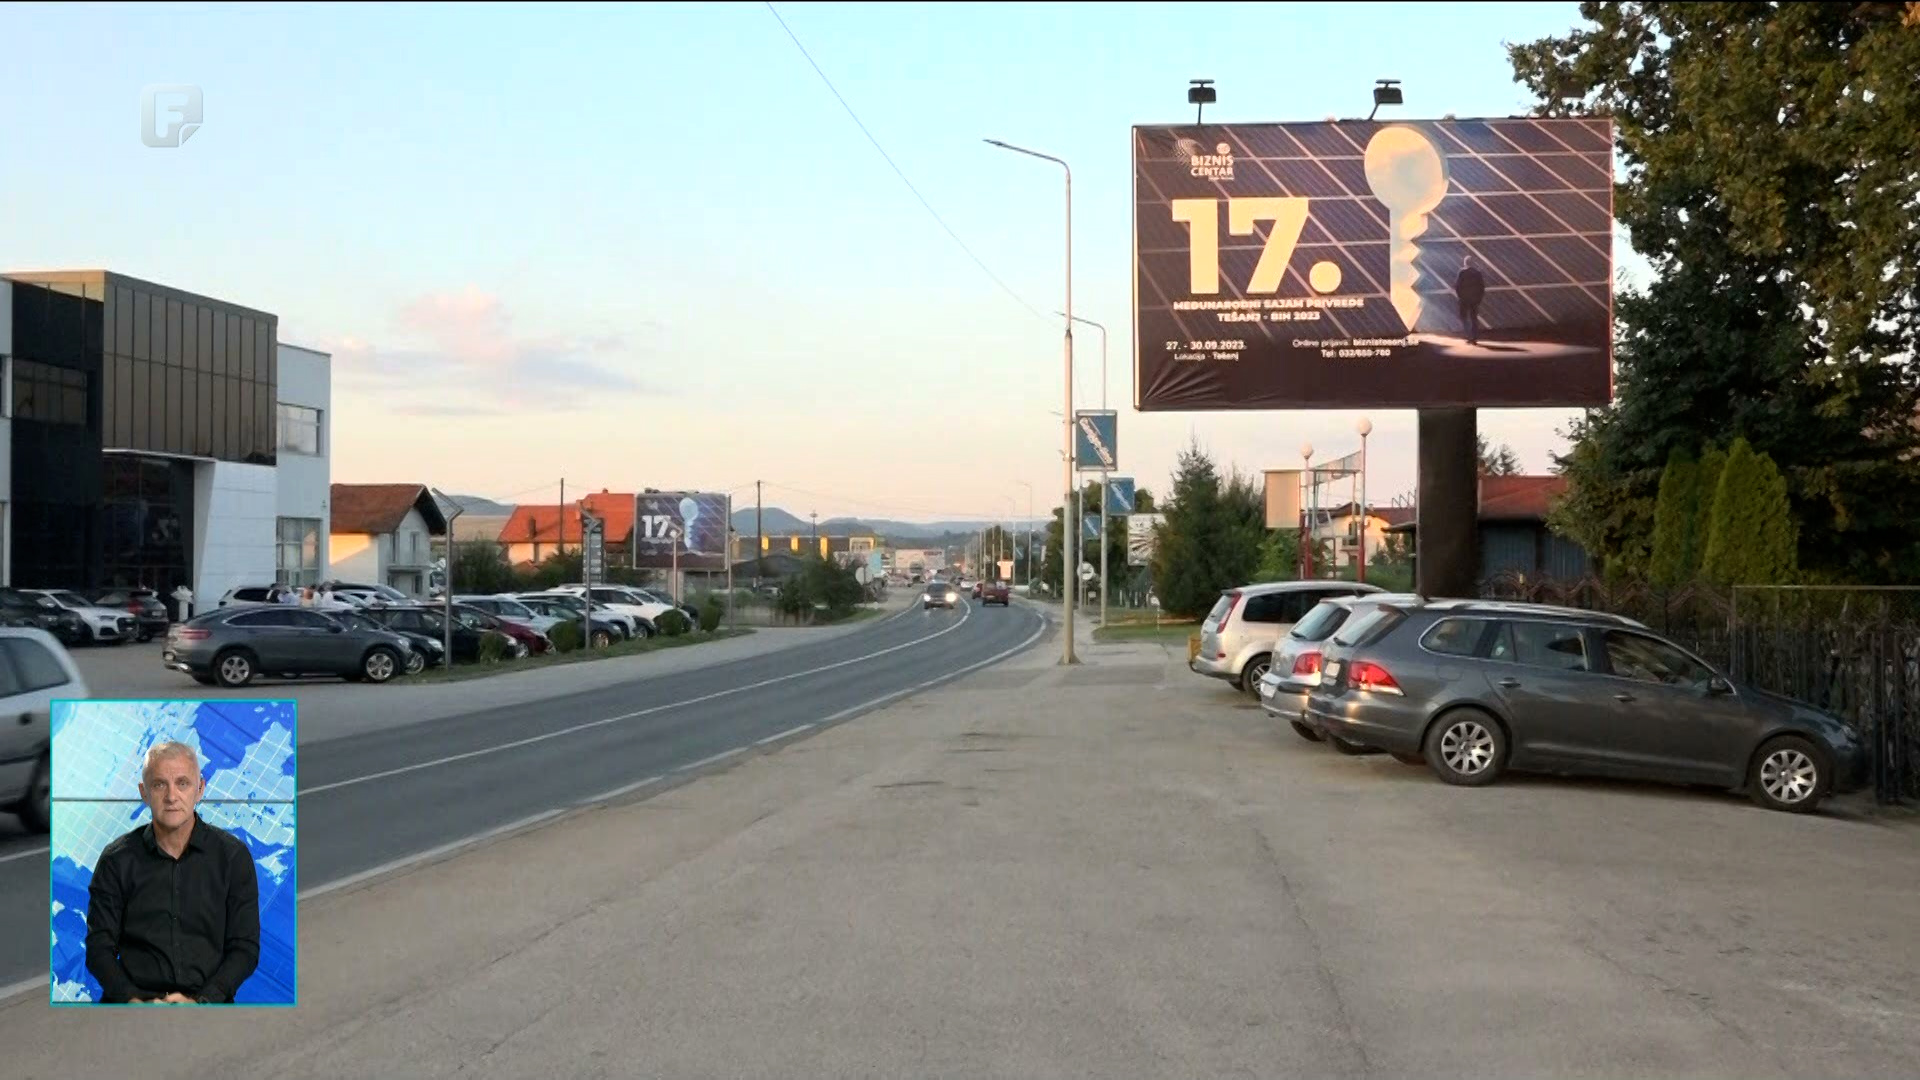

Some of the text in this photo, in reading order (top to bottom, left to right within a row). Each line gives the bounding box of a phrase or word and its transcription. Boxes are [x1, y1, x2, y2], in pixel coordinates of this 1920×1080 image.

[1190, 154, 1234, 166] BIZNIS
[1190, 167, 1234, 177] CENTAR
[1172, 197, 1342, 294] 17.
[1263, 299, 1302, 310] SAJAM
[1305, 298, 1364, 309] PRIVREDE
[1217, 311, 1261, 322] TEŠANJ
[1293, 311, 1321, 321] 2023
